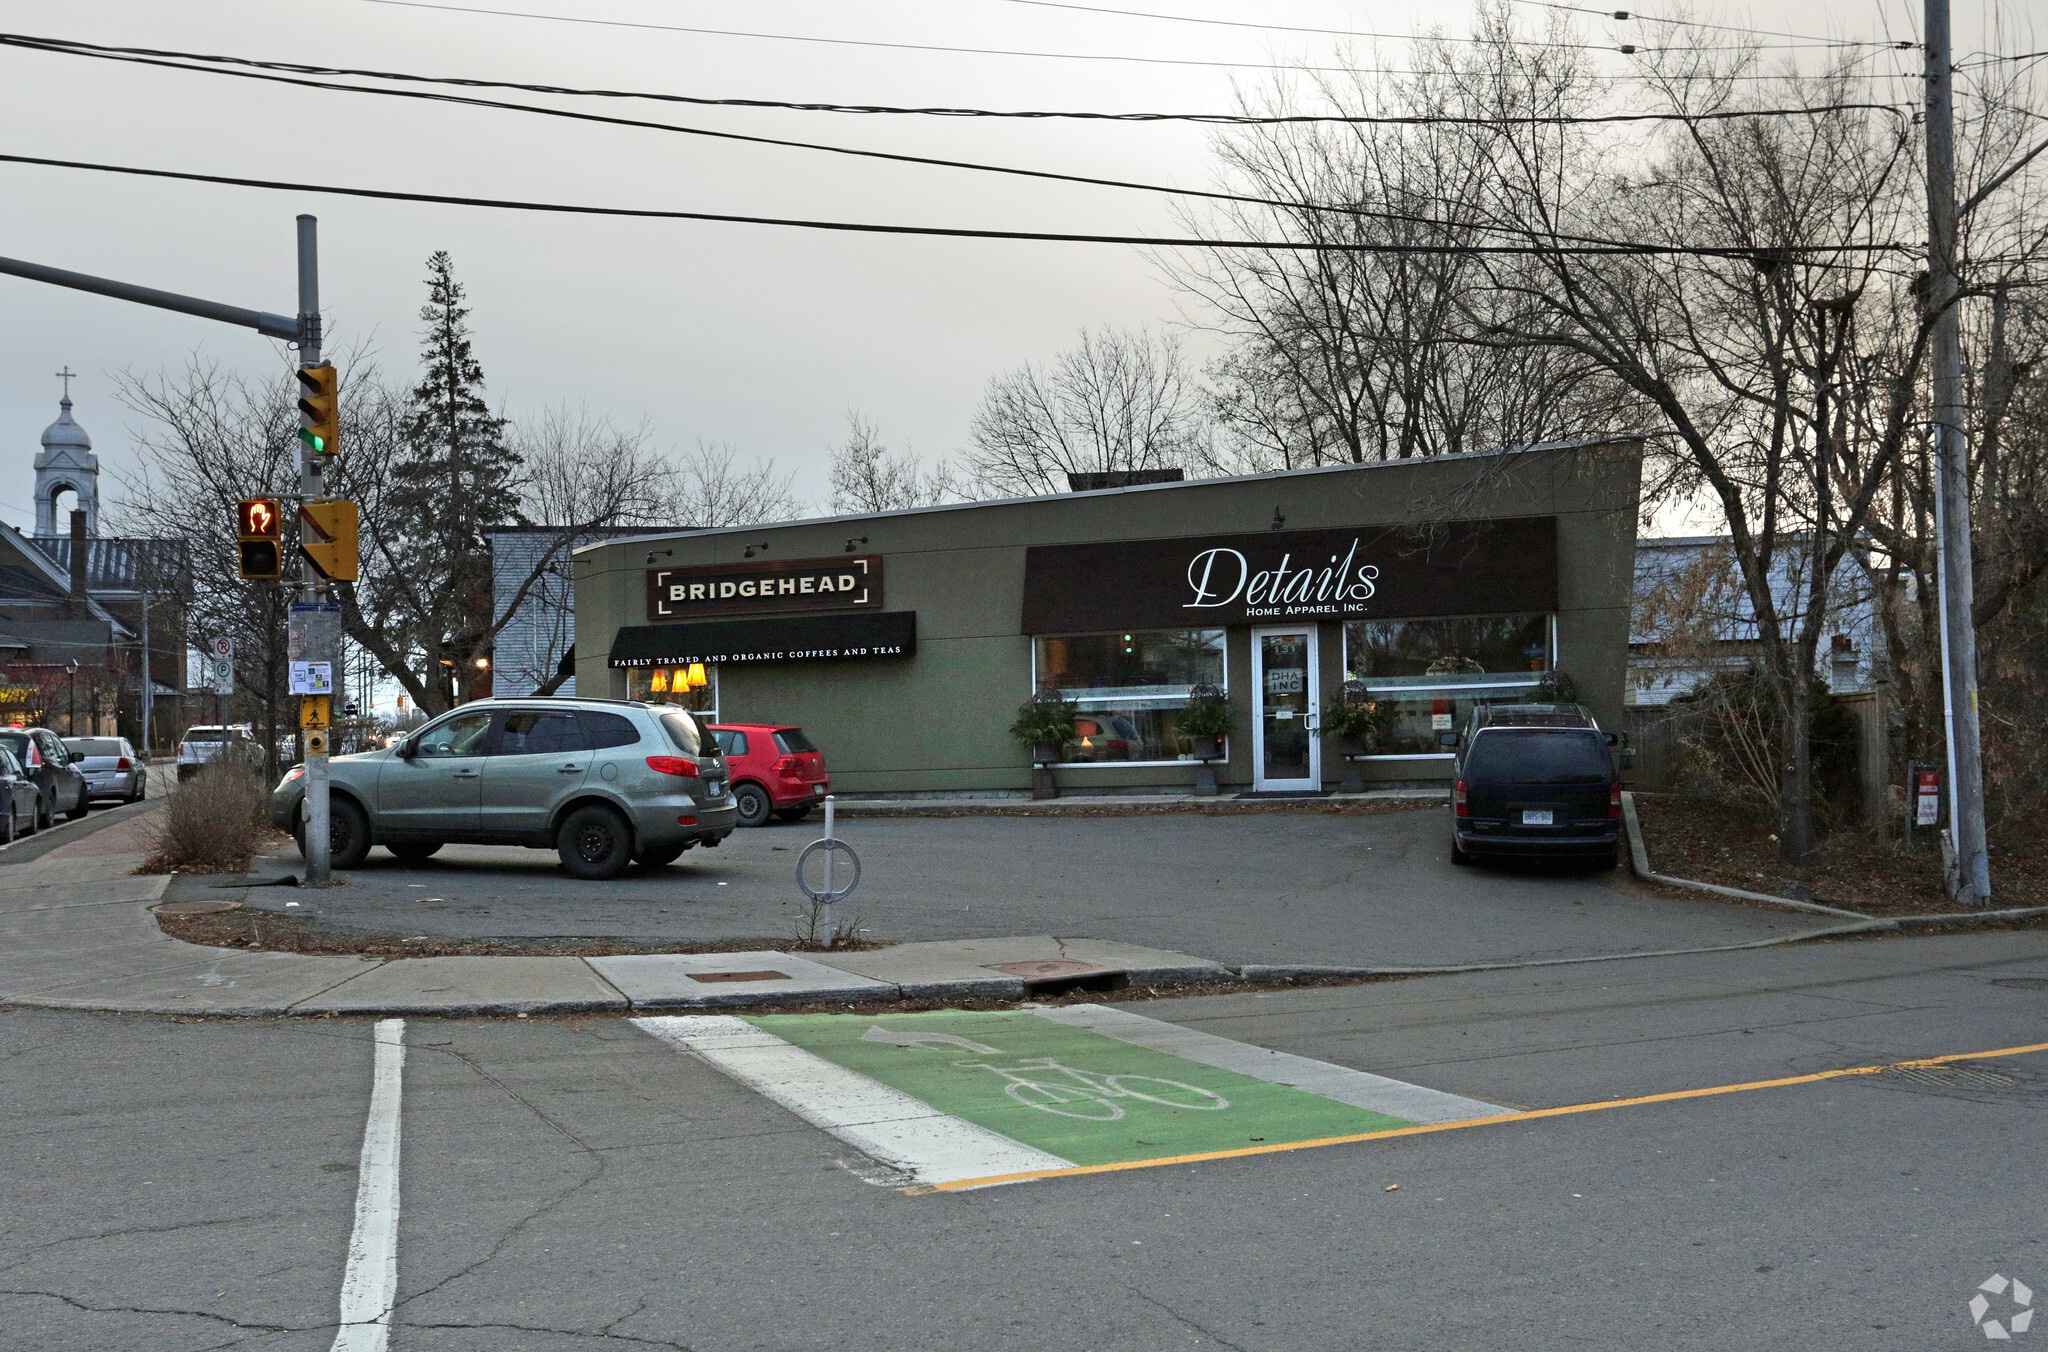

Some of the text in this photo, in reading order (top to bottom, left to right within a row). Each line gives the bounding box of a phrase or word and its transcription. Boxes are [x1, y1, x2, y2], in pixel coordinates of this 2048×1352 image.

[1182, 537, 1379, 608] Details
[669, 574, 856, 601] BRIDGEHEAD
[614, 646, 901, 667] FAIRLY TRADED AND ORGANIC COFFEES AND TEAS
[1273, 645, 1296, 653] 131
[1272, 672, 1299, 681] DHA
[1273, 681, 1299, 690] INC
